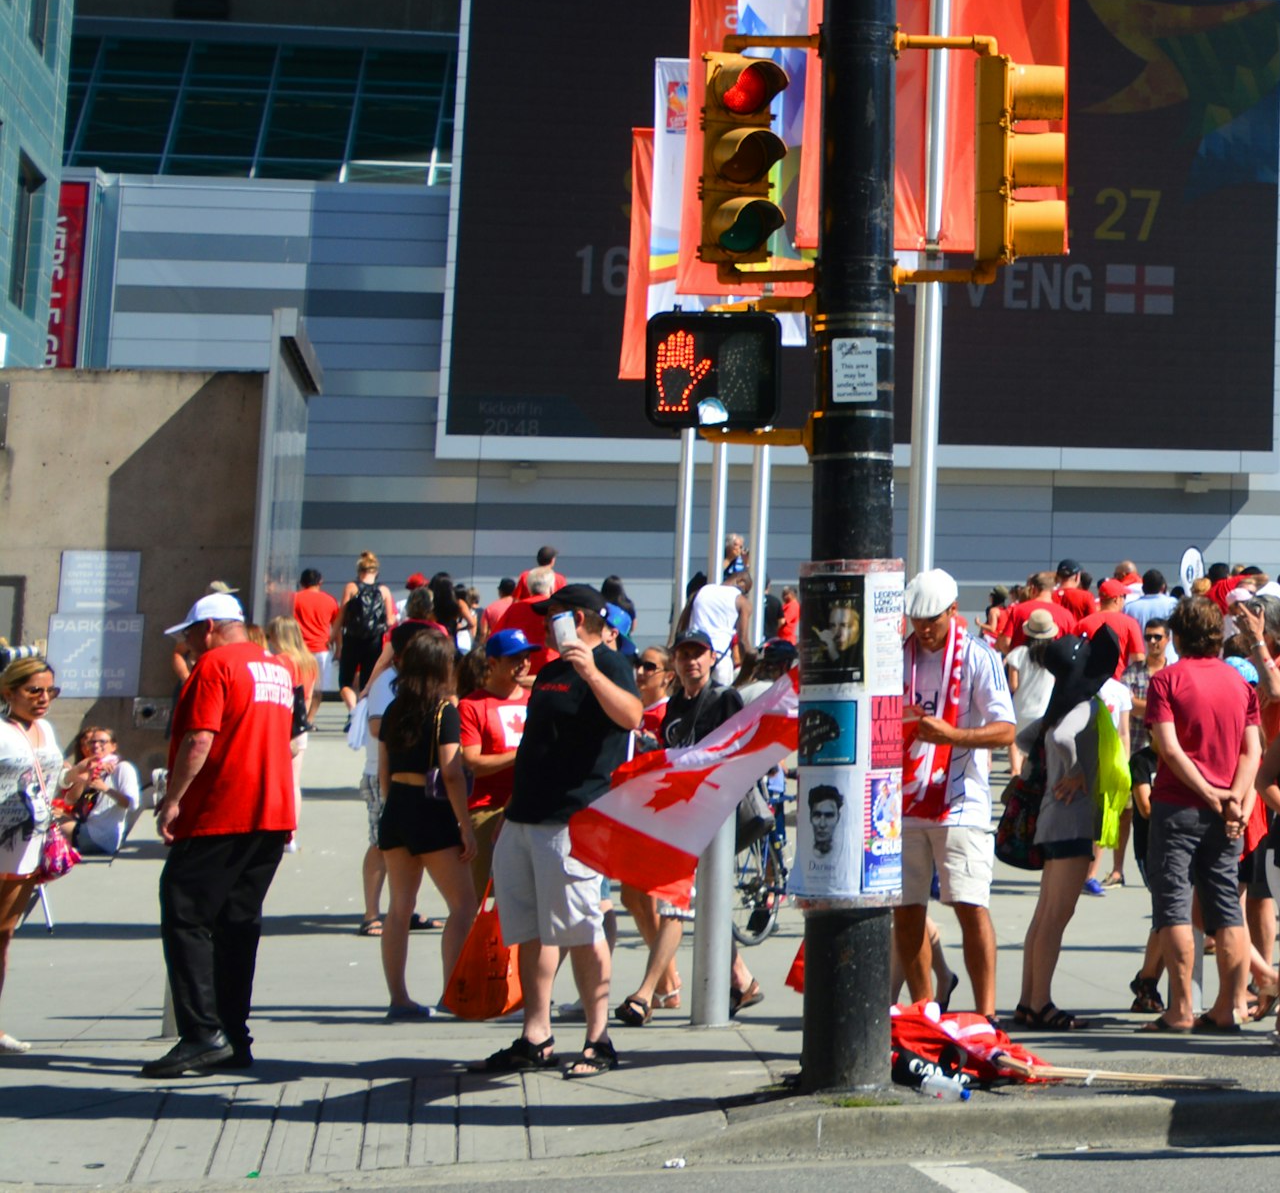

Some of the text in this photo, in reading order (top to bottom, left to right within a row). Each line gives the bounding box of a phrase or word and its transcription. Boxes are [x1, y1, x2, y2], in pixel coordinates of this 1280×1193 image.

[1093, 188, 1163, 242] 27
[1002, 262, 1093, 312] ENG
[483, 417, 540, 436] 20:48
[52, 619, 141, 633] PARKADE
[63, 669, 126, 679] TO LEVELS
